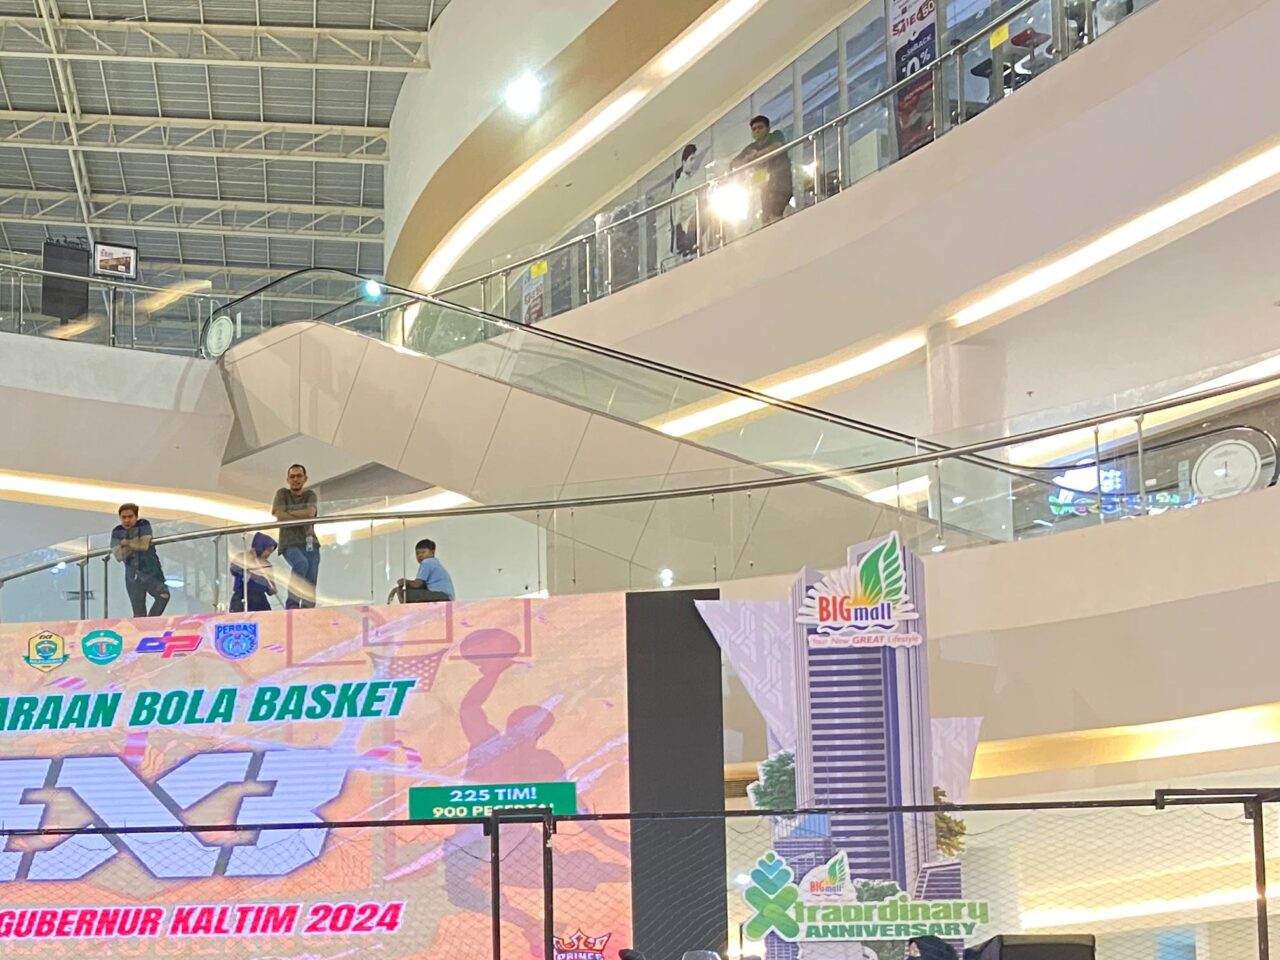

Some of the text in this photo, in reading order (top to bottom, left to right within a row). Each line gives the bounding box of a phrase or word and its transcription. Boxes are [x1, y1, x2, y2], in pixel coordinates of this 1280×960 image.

[852, 636, 884, 645] GREAT
[128, 688, 238, 728] BOLA
[248, 679, 418, 722] BASKET
[449, 786, 537, 802] 225 TIM!
[432, 805, 468, 818] 900
[169, 903, 300, 935] KALTIM
[304, 902, 405, 932] 2024
[805, 921, 977, 938] ANNIVERSARY
